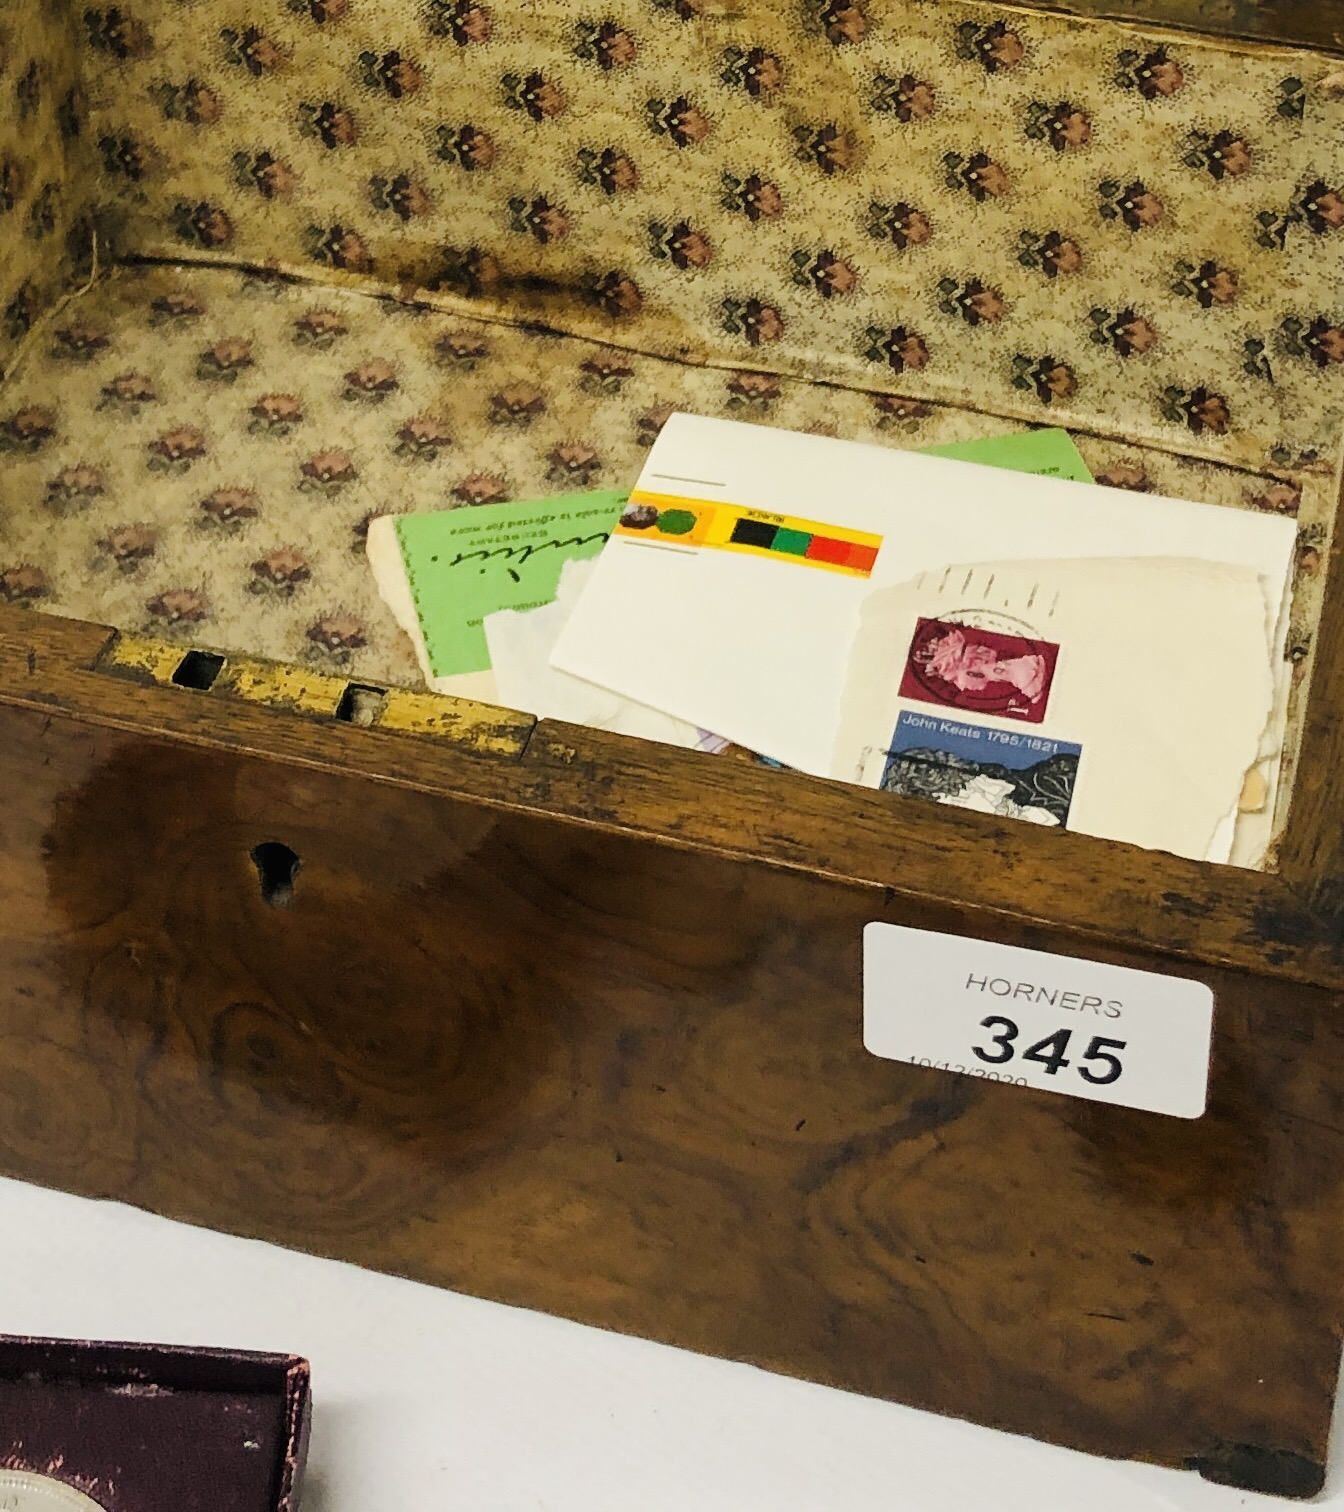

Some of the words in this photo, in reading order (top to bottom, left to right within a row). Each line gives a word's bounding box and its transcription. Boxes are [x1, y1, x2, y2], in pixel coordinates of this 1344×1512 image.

[902, 713, 938, 732] John
[939, 722, 982, 740] Keats
[987, 730, 1059, 754] 1795/1821
[965, 972, 1125, 1020] HORNERS
[971, 1015, 1128, 1085] 345
